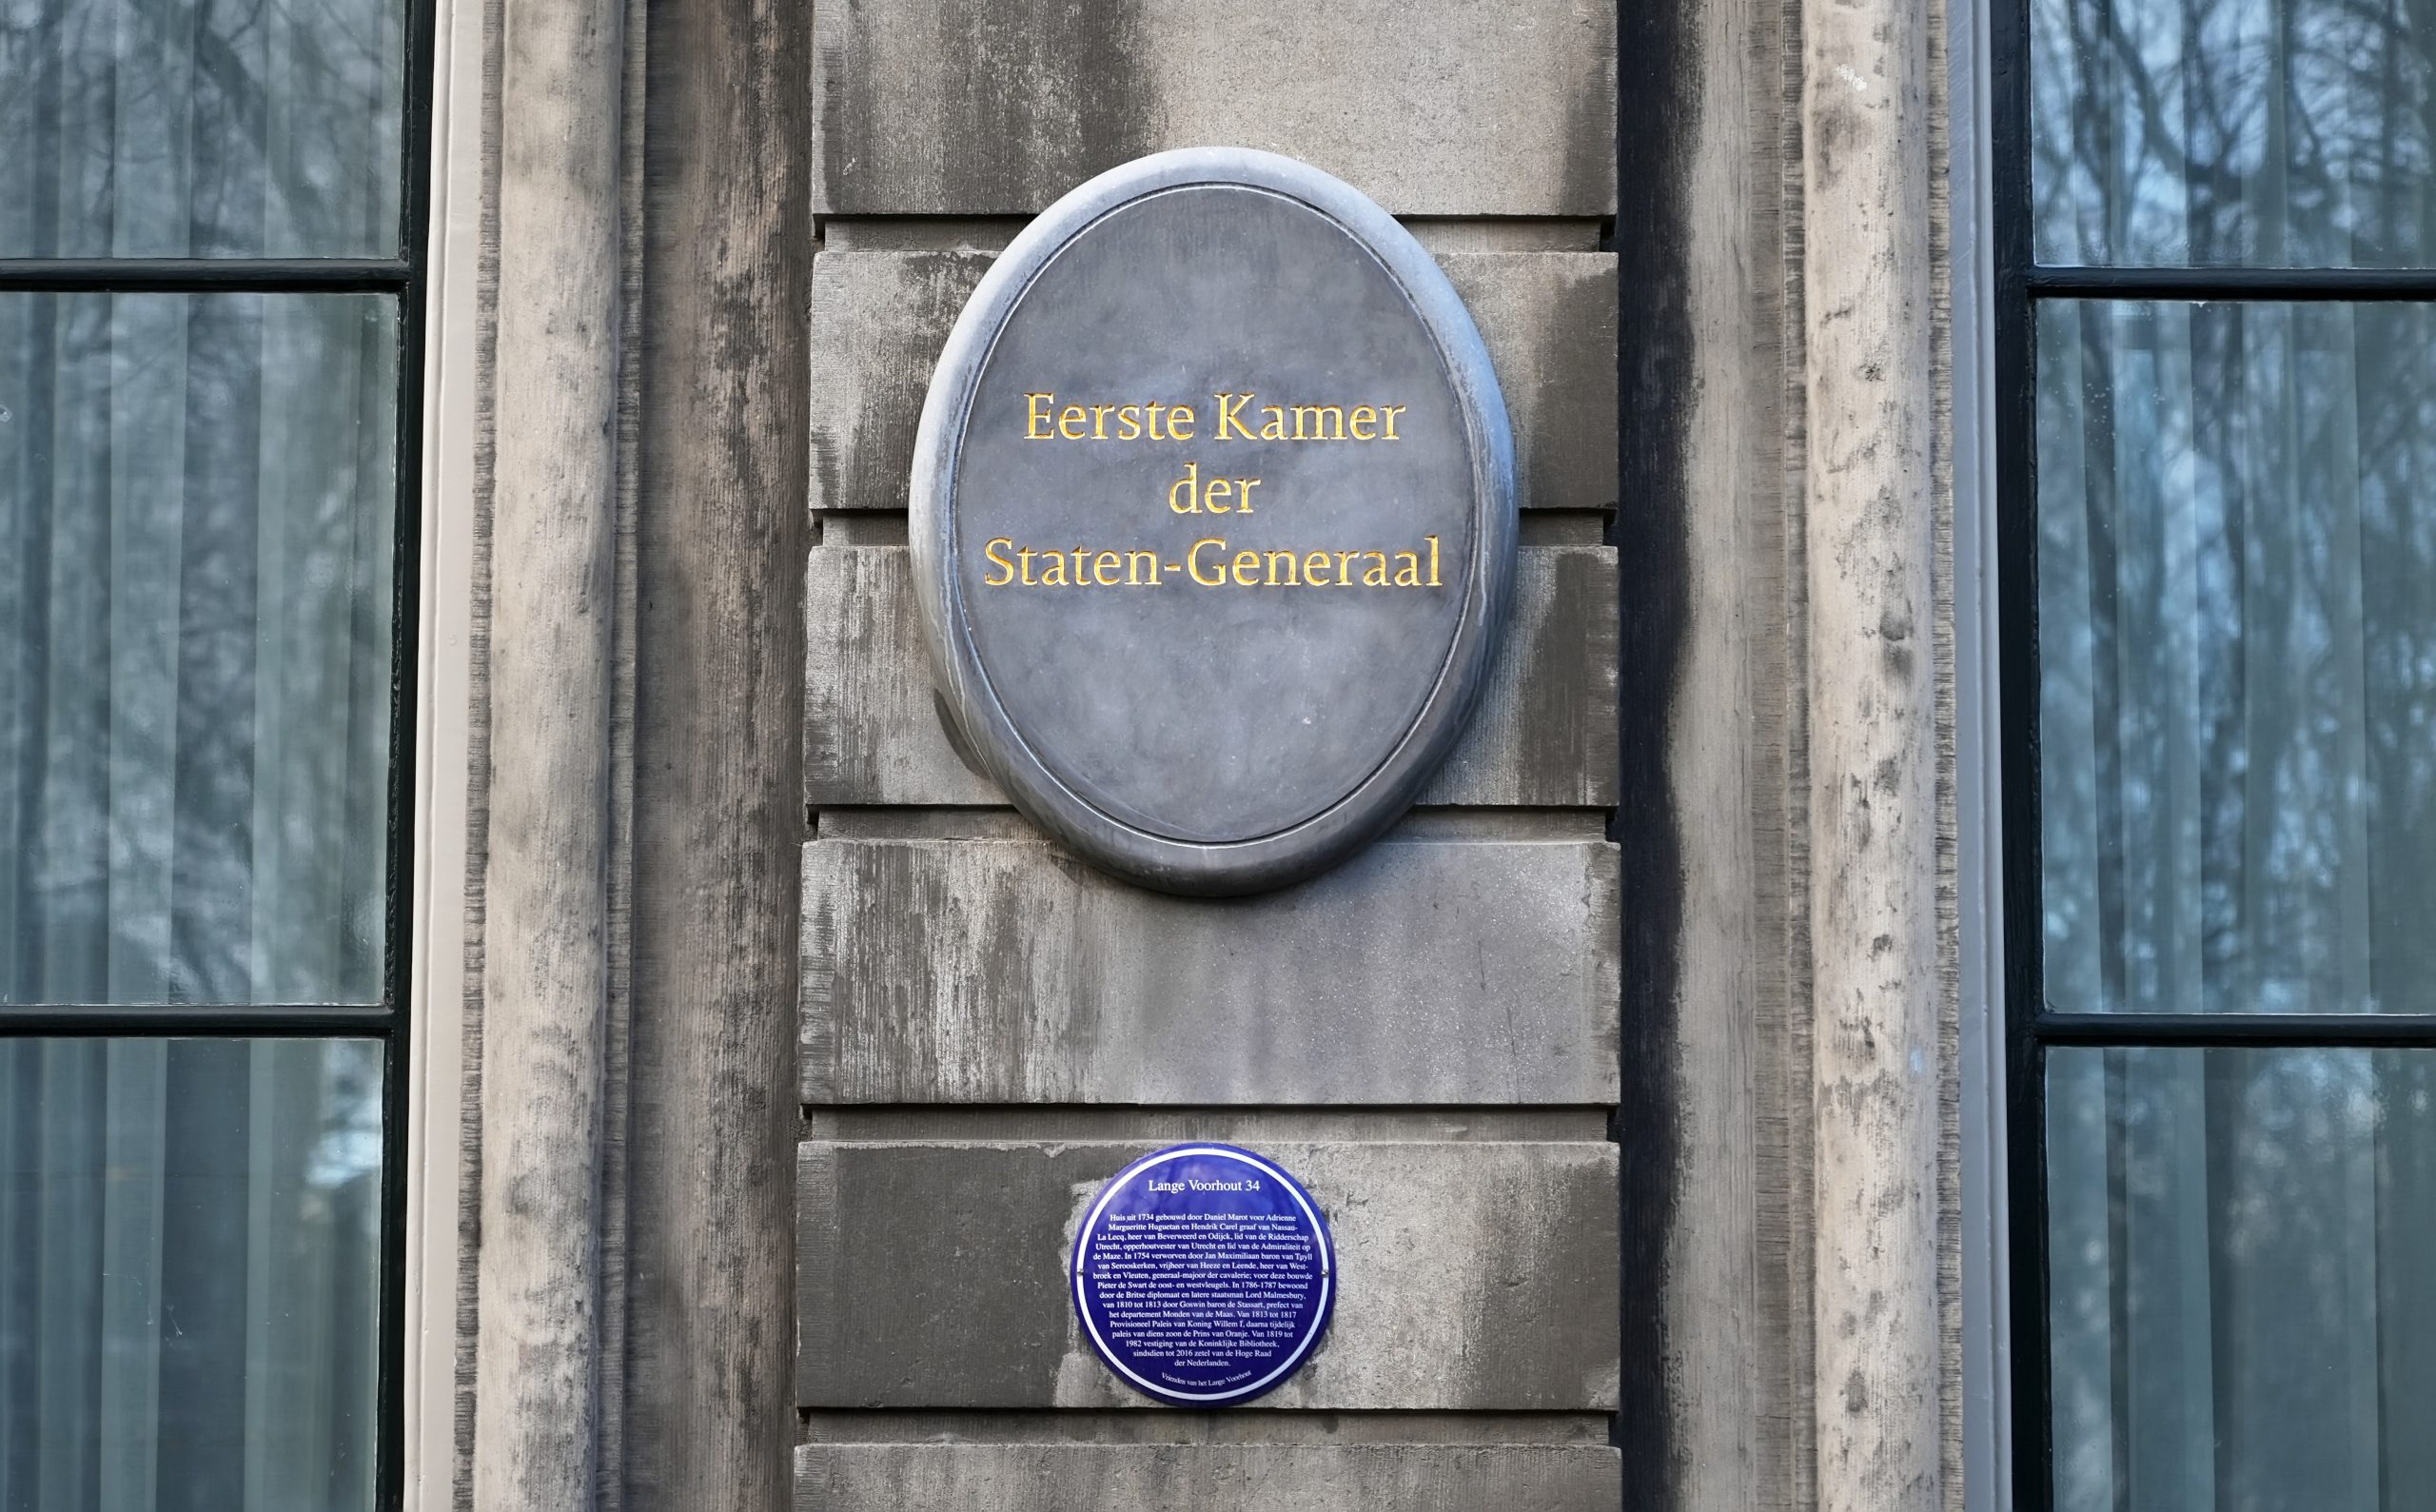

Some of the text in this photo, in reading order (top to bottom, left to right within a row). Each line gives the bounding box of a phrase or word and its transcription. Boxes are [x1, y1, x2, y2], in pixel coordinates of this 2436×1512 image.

[1023, 392, 1406, 442] Eerste Kamer
[1169, 461, 1262, 514] der
[984, 535, 1444, 587] Staten-Generaal
[1149, 1179, 1261, 1194] Lange Voorhout 34
[1155, 1214, 1186, 1223] gebouwd
[1108, 1224, 1147, 1232] Margueritte
[1148, 1224, 1180, 1232] Huguetan
[1239, 1224, 1257, 1232] graaf
[1267, 1233, 1308, 1243] Ridderschap
[1123, 1243, 1176, 1252] opperhoutvester
[1159, 1262, 1185, 1271] vrijheer
[1232, 1262, 1259, 1270] Leende,
[1151, 1272, 1206, 1281] generaal-majoor
[1186, 1282, 1230, 1290] westvleugels.
[1147, 1291, 1180, 1300] diplomaat
[1263, 1291, 1306, 1301] Malmesbury,
[1237, 1301, 1265, 1309] Stassart,
[1267, 1302, 1289, 1310] prefect
[1120, 1311, 1161, 1320] departement
[1188, 1321, 1212, 1329] Koning
[1269, 1321, 1295, 1329] tijdelijk
[1111, 1330, 1131, 1340] paleis
[1225, 1330, 1249, 1339] Oranje.
[1143, 1340, 1173, 1349] vestiging
[1198, 1340, 1237, 1348] Koninklijke
[1239, 1340, 1279, 1348] Bibliotheek,
[1235, 1350, 1253, 1359] Hoge
[1162, 1372, 1187, 1385] Vrienden
[1208, 1379, 1226, 1387] Lange
[1226, 1370, 1252, 1384] Voorhout
